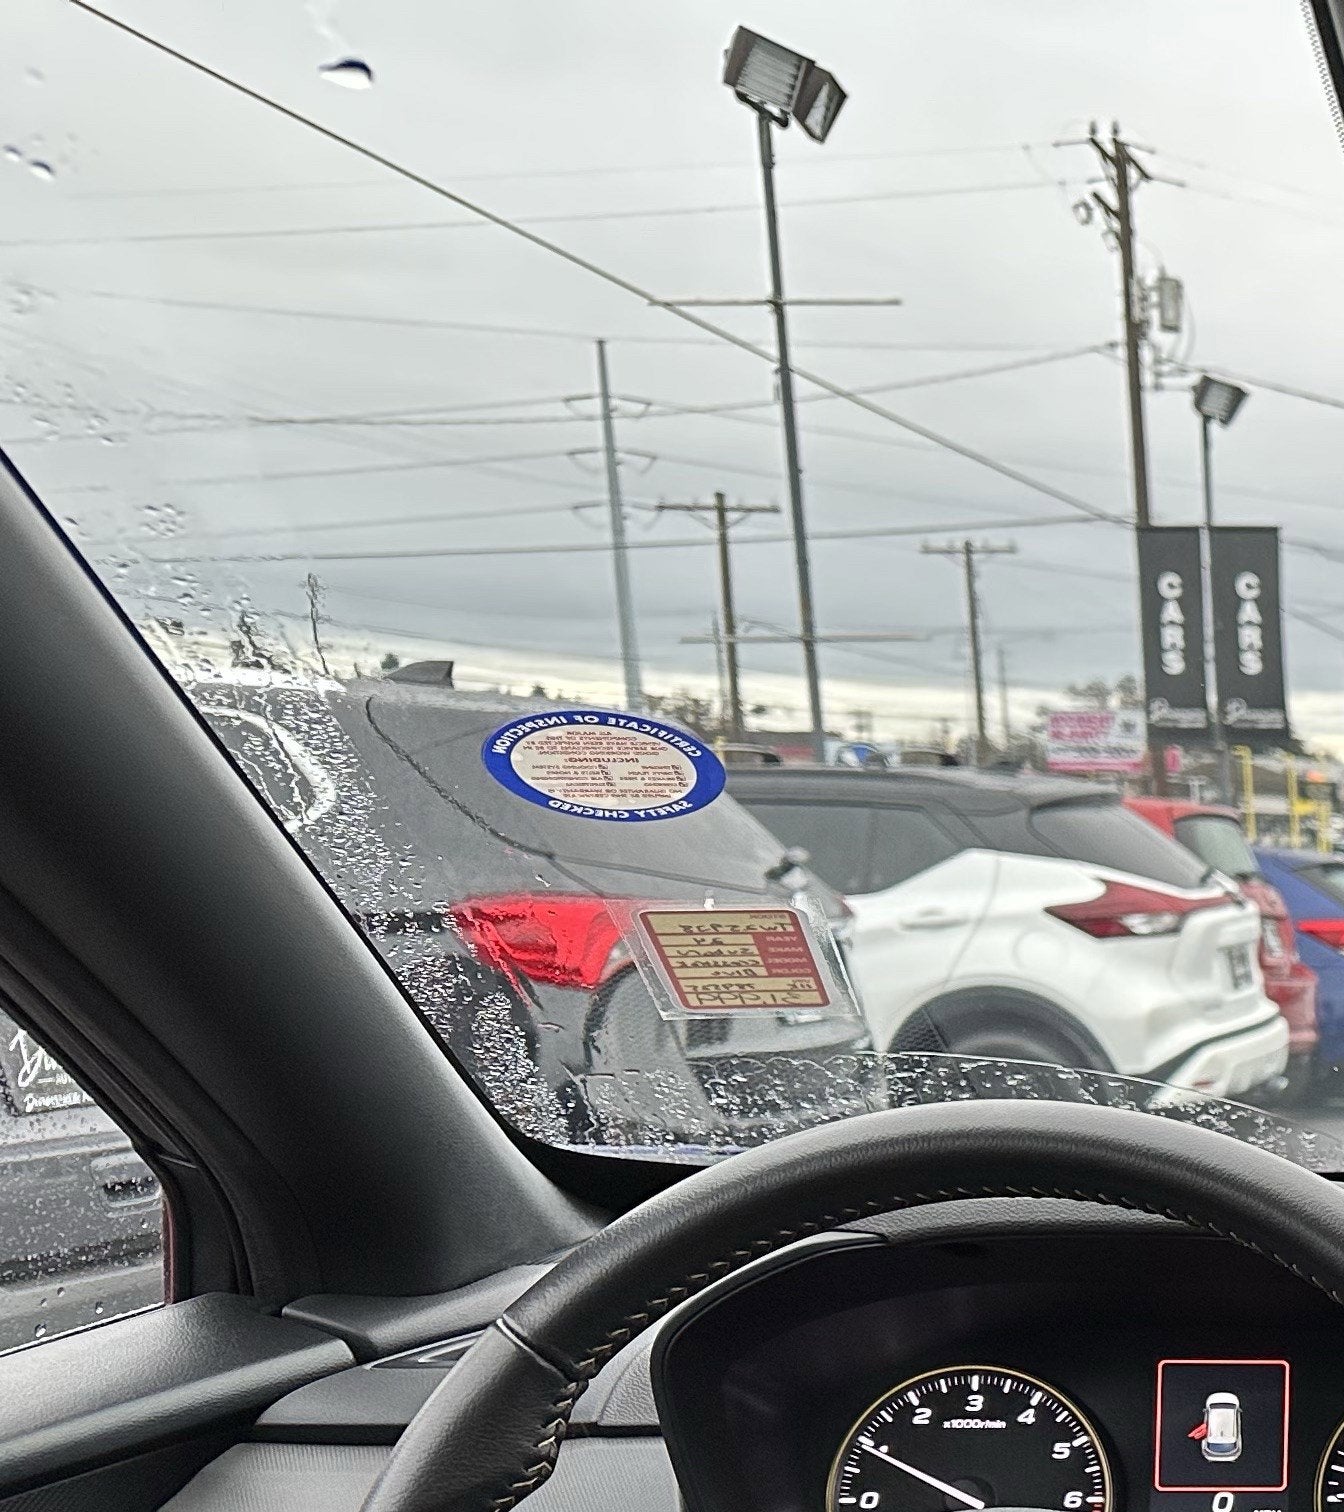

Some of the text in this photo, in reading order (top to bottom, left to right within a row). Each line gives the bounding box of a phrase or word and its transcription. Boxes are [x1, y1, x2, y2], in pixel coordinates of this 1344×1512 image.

[1157, 571, 1186, 675] CARS
[1235, 571, 1263, 675] CARS
[965, 1394, 984, 1411] 3
[912, 1408, 932, 1425] 2
[1016, 1408, 1036, 1425] 4
[1052, 1442, 1072, 1459] 5
[859, 1491, 879, 1509] 0
[1063, 1491, 1083, 1508] 6
